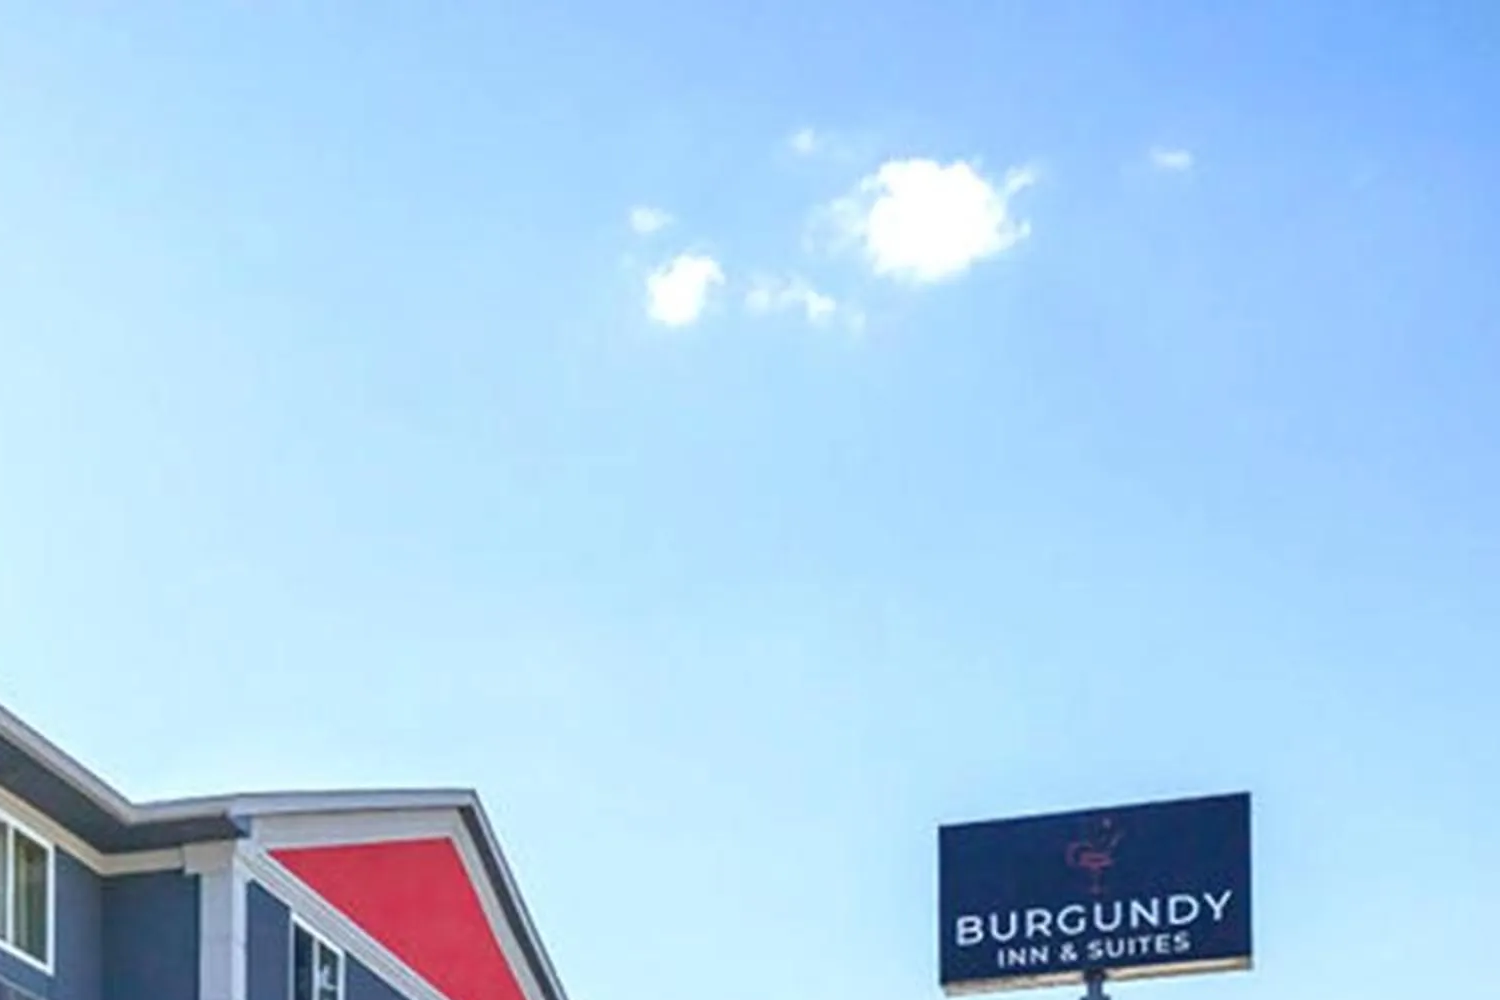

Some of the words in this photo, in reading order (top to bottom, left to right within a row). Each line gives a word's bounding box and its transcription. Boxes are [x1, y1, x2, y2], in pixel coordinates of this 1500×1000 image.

[956, 890, 1232, 945] BURGUNDY
[998, 947, 1049, 968] INN
[1059, 944, 1078, 962] &
[1087, 931, 1190, 961] SUITES
